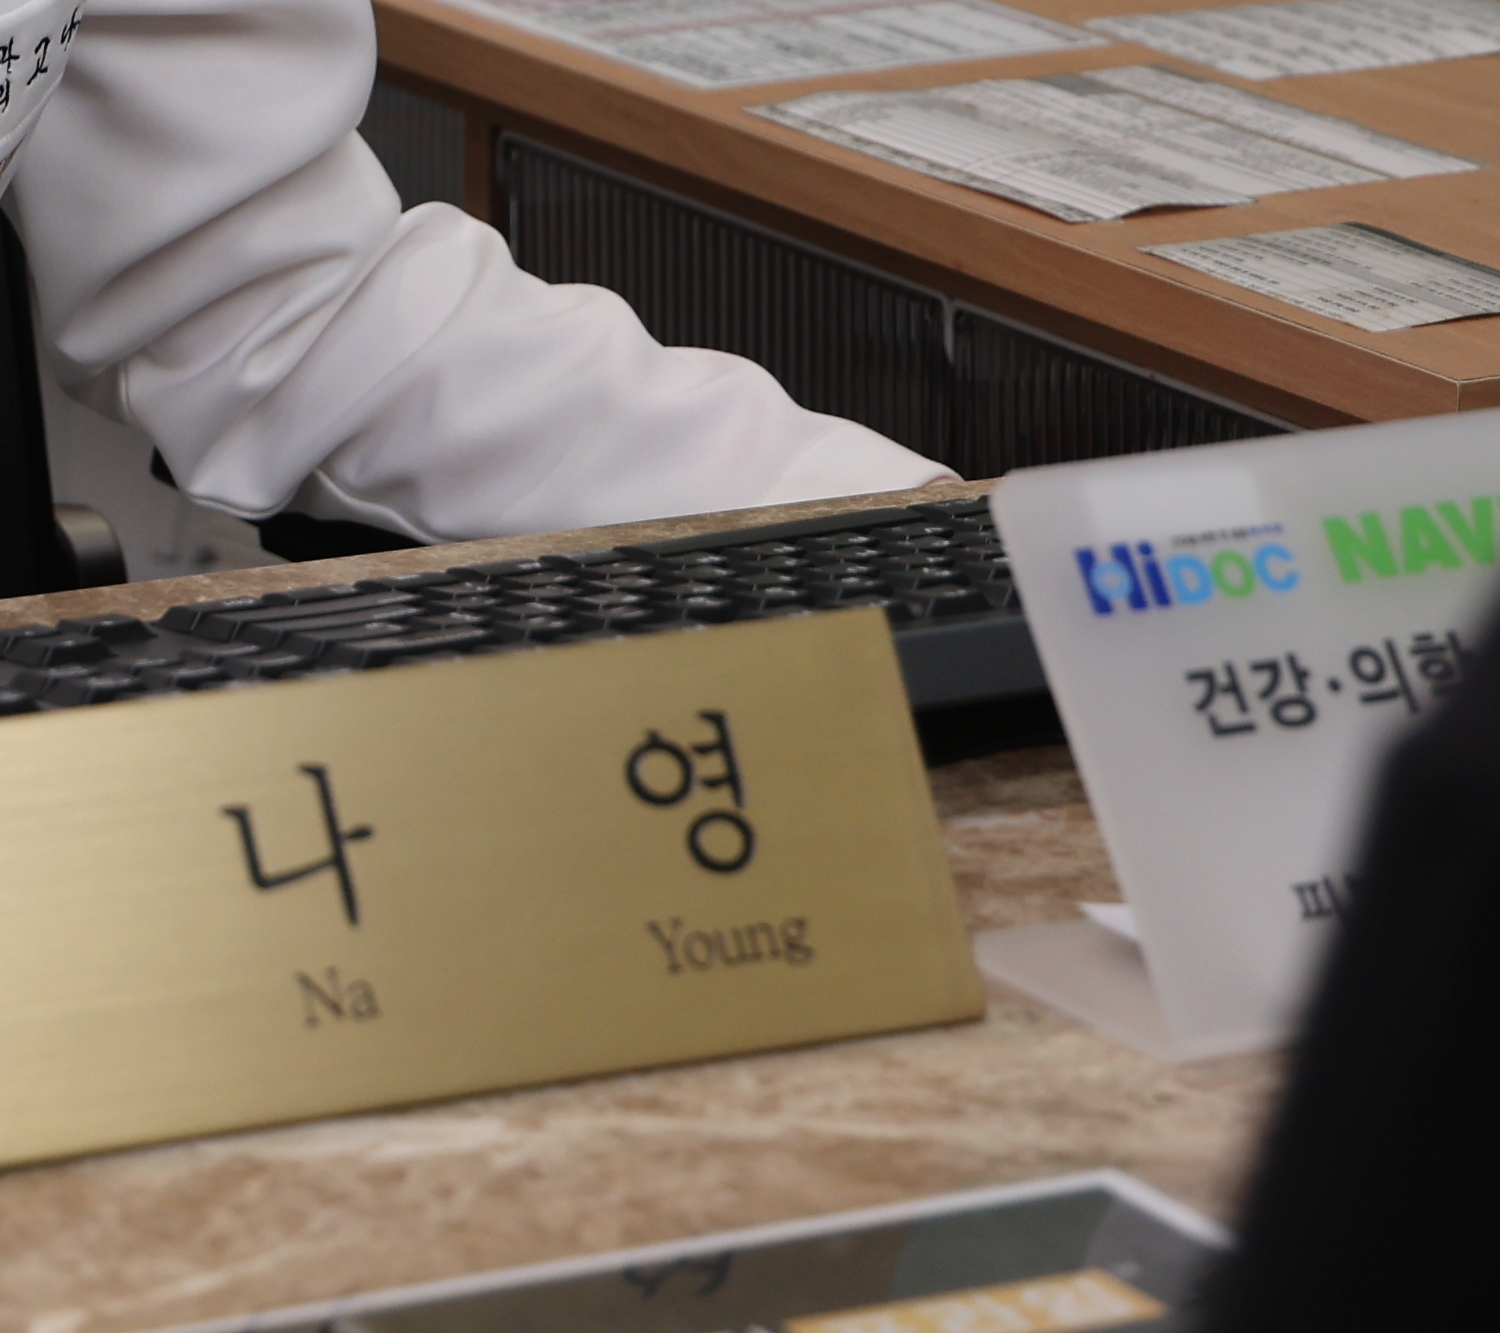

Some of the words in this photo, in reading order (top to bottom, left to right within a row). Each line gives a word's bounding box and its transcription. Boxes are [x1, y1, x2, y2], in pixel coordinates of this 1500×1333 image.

[219, 760, 374, 927] 나
[624, 708, 757, 874] 영
[296, 965, 381, 1028] Na
[645, 916, 817, 976] Young
